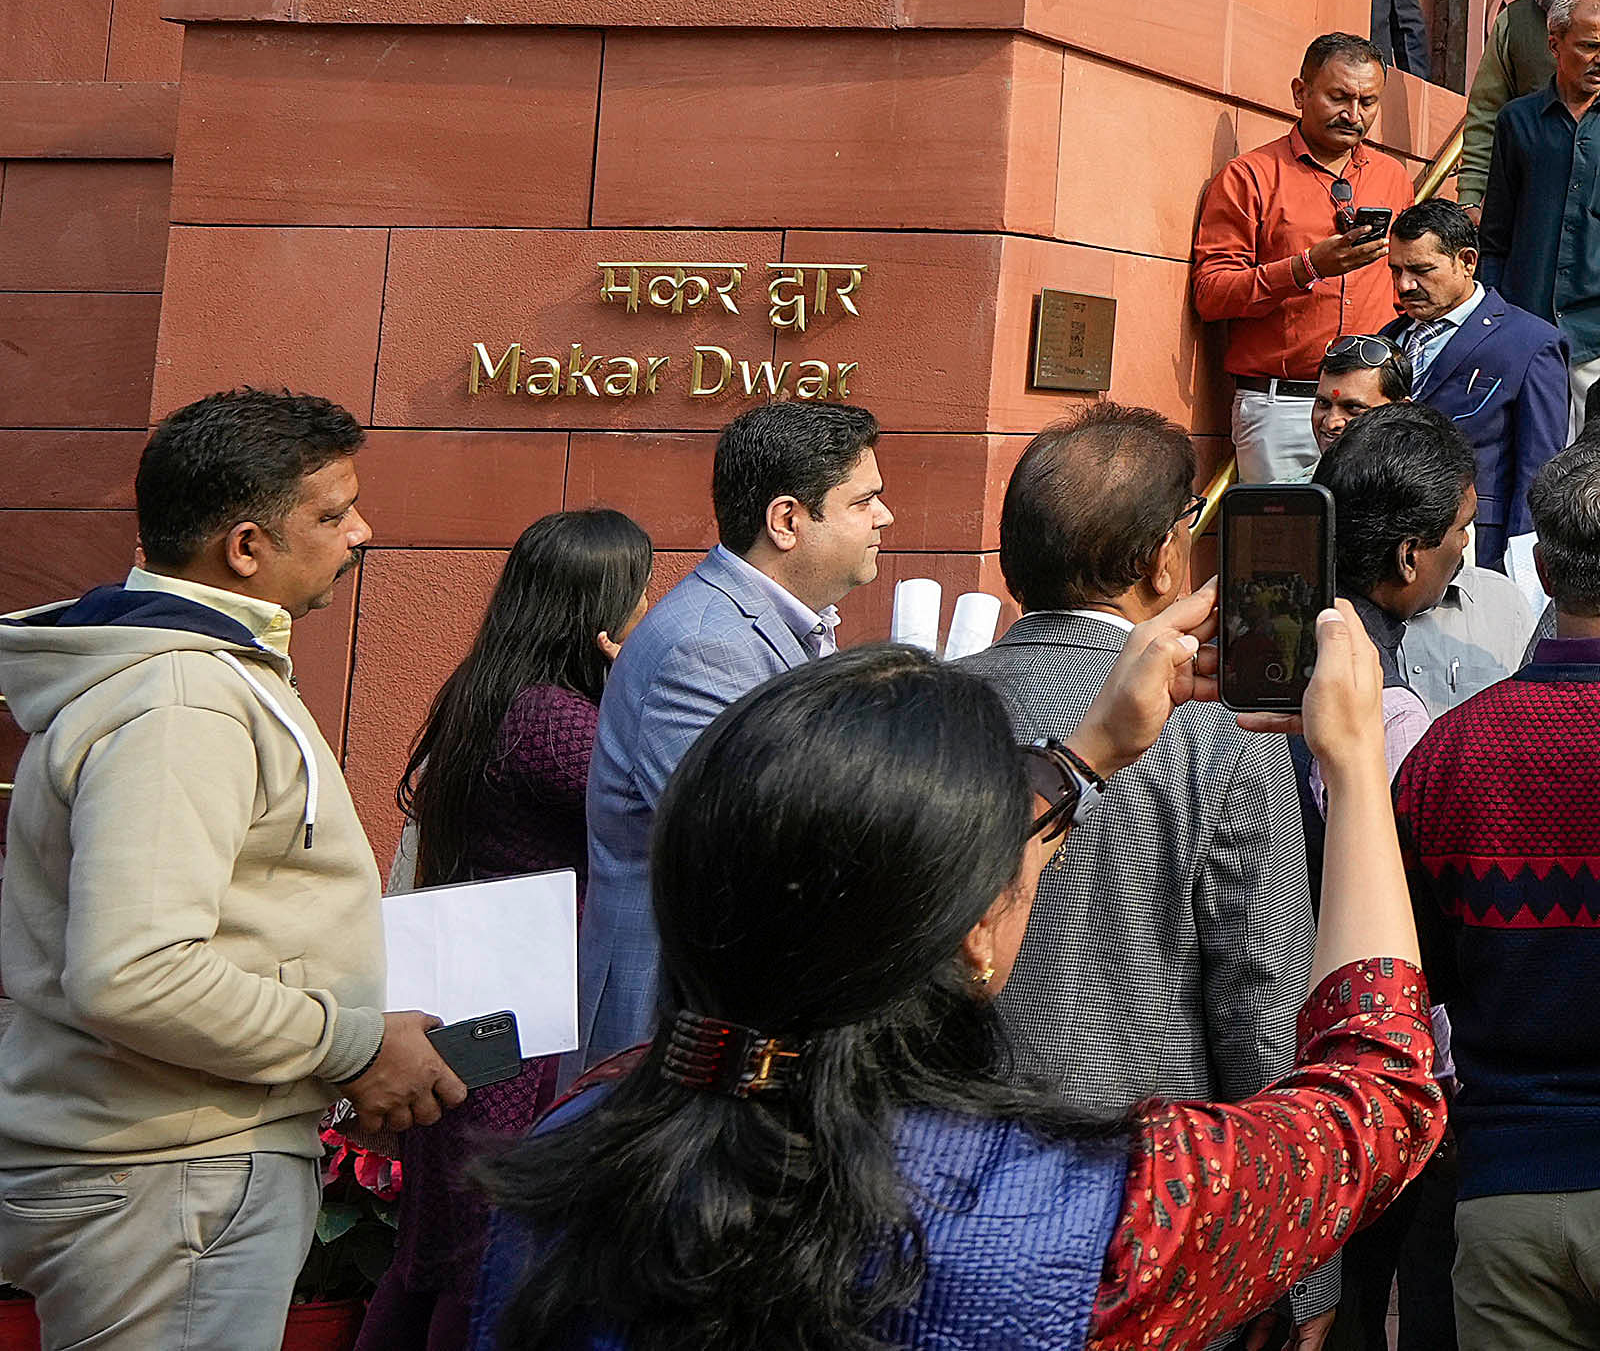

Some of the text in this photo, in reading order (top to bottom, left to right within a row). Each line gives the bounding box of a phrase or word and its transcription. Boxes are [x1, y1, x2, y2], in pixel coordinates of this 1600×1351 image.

[597, 261, 868, 332] मकर द्वार
[468, 342, 859, 399] Makar Dwar
